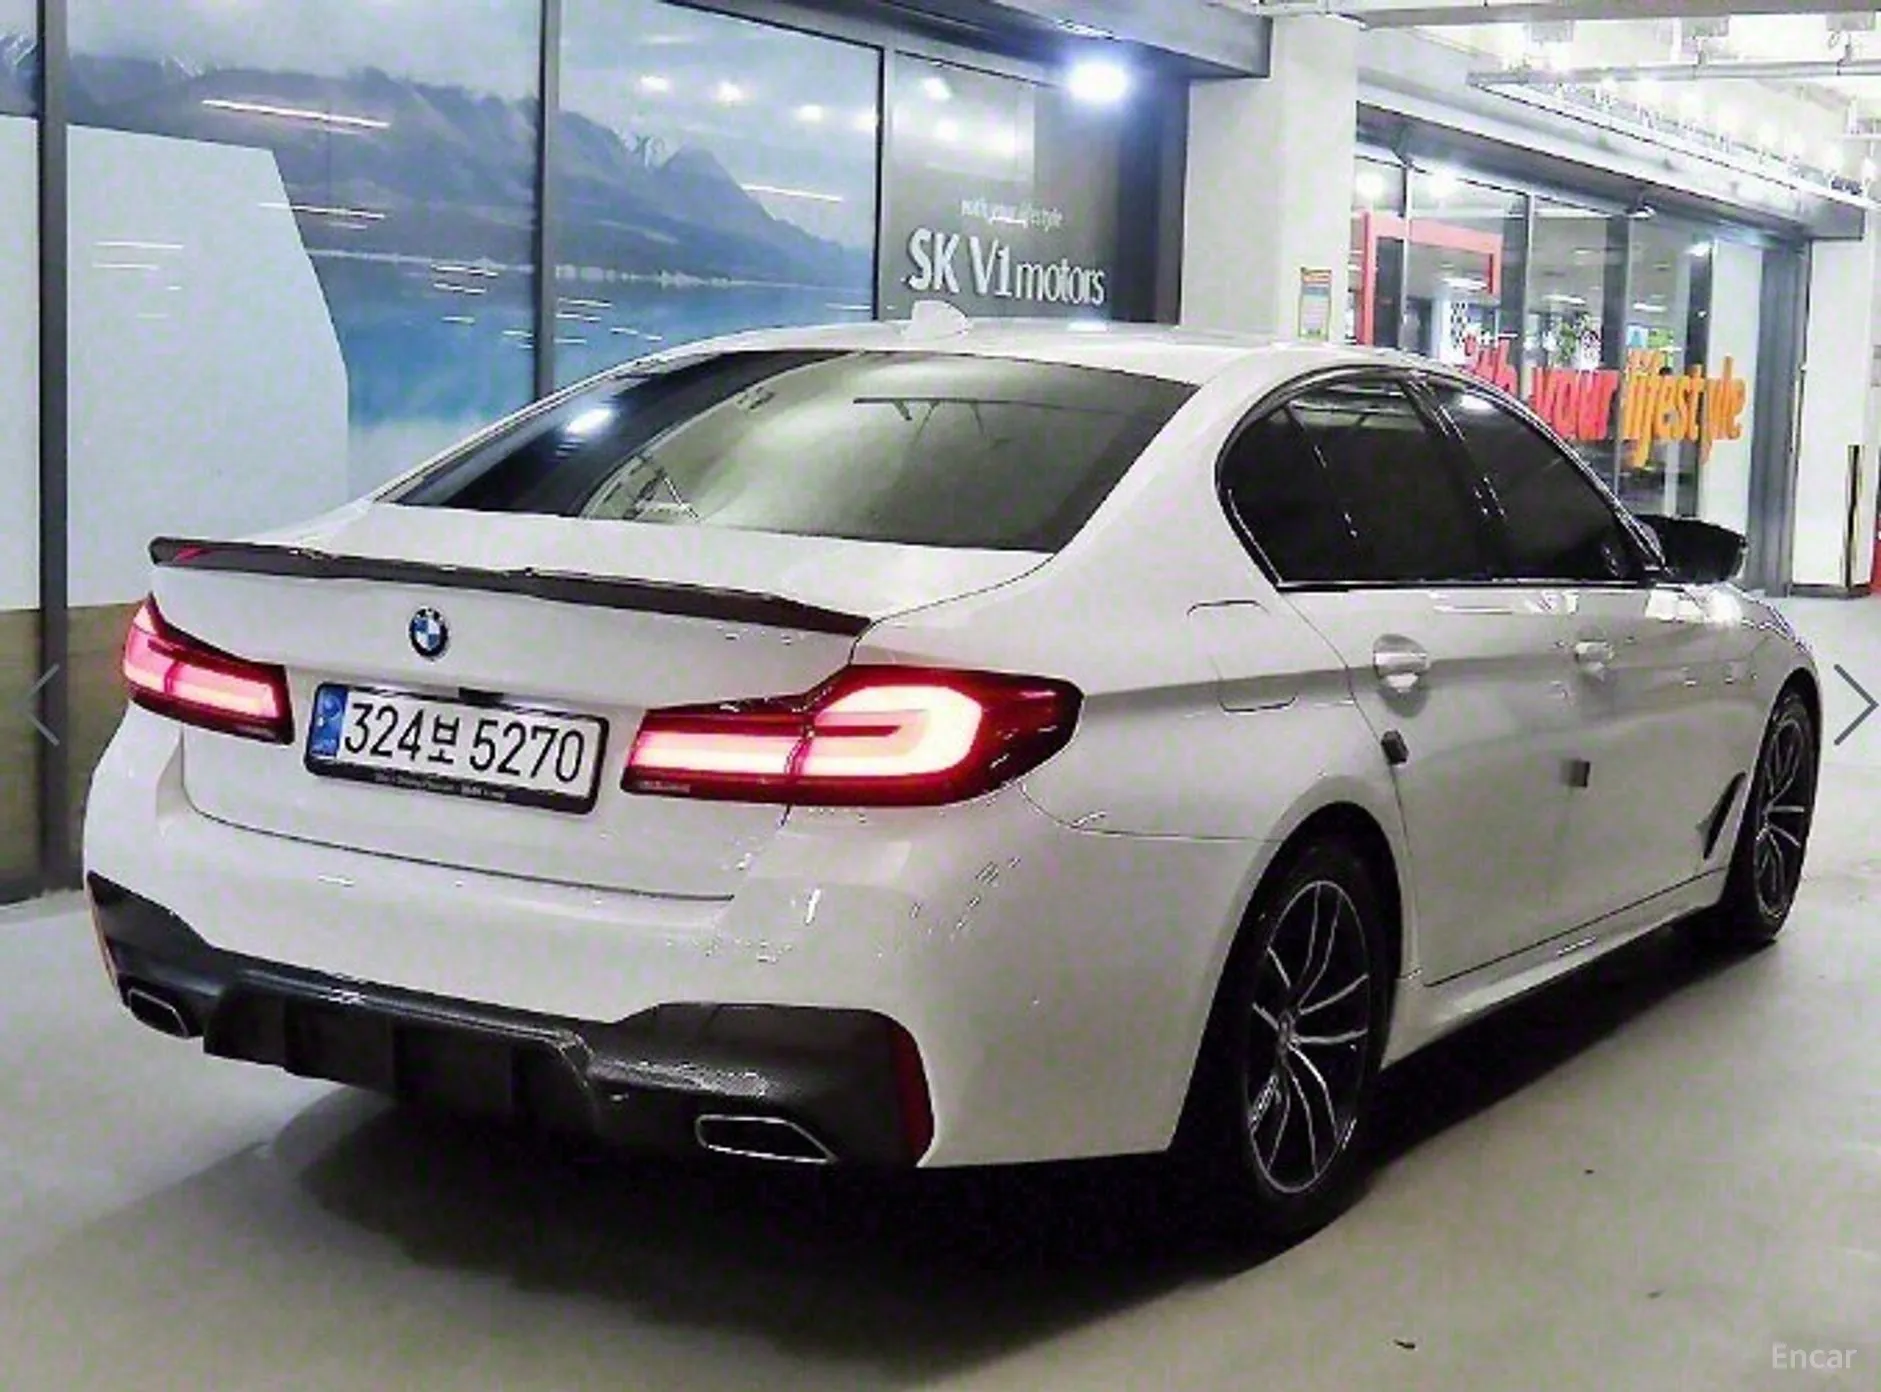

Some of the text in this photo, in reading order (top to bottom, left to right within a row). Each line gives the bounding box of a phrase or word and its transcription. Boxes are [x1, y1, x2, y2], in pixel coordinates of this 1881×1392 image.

[907, 228, 960, 294] SK
[1622, 349, 1746, 468] lifestyle
[468, 719, 585, 783] 5270
